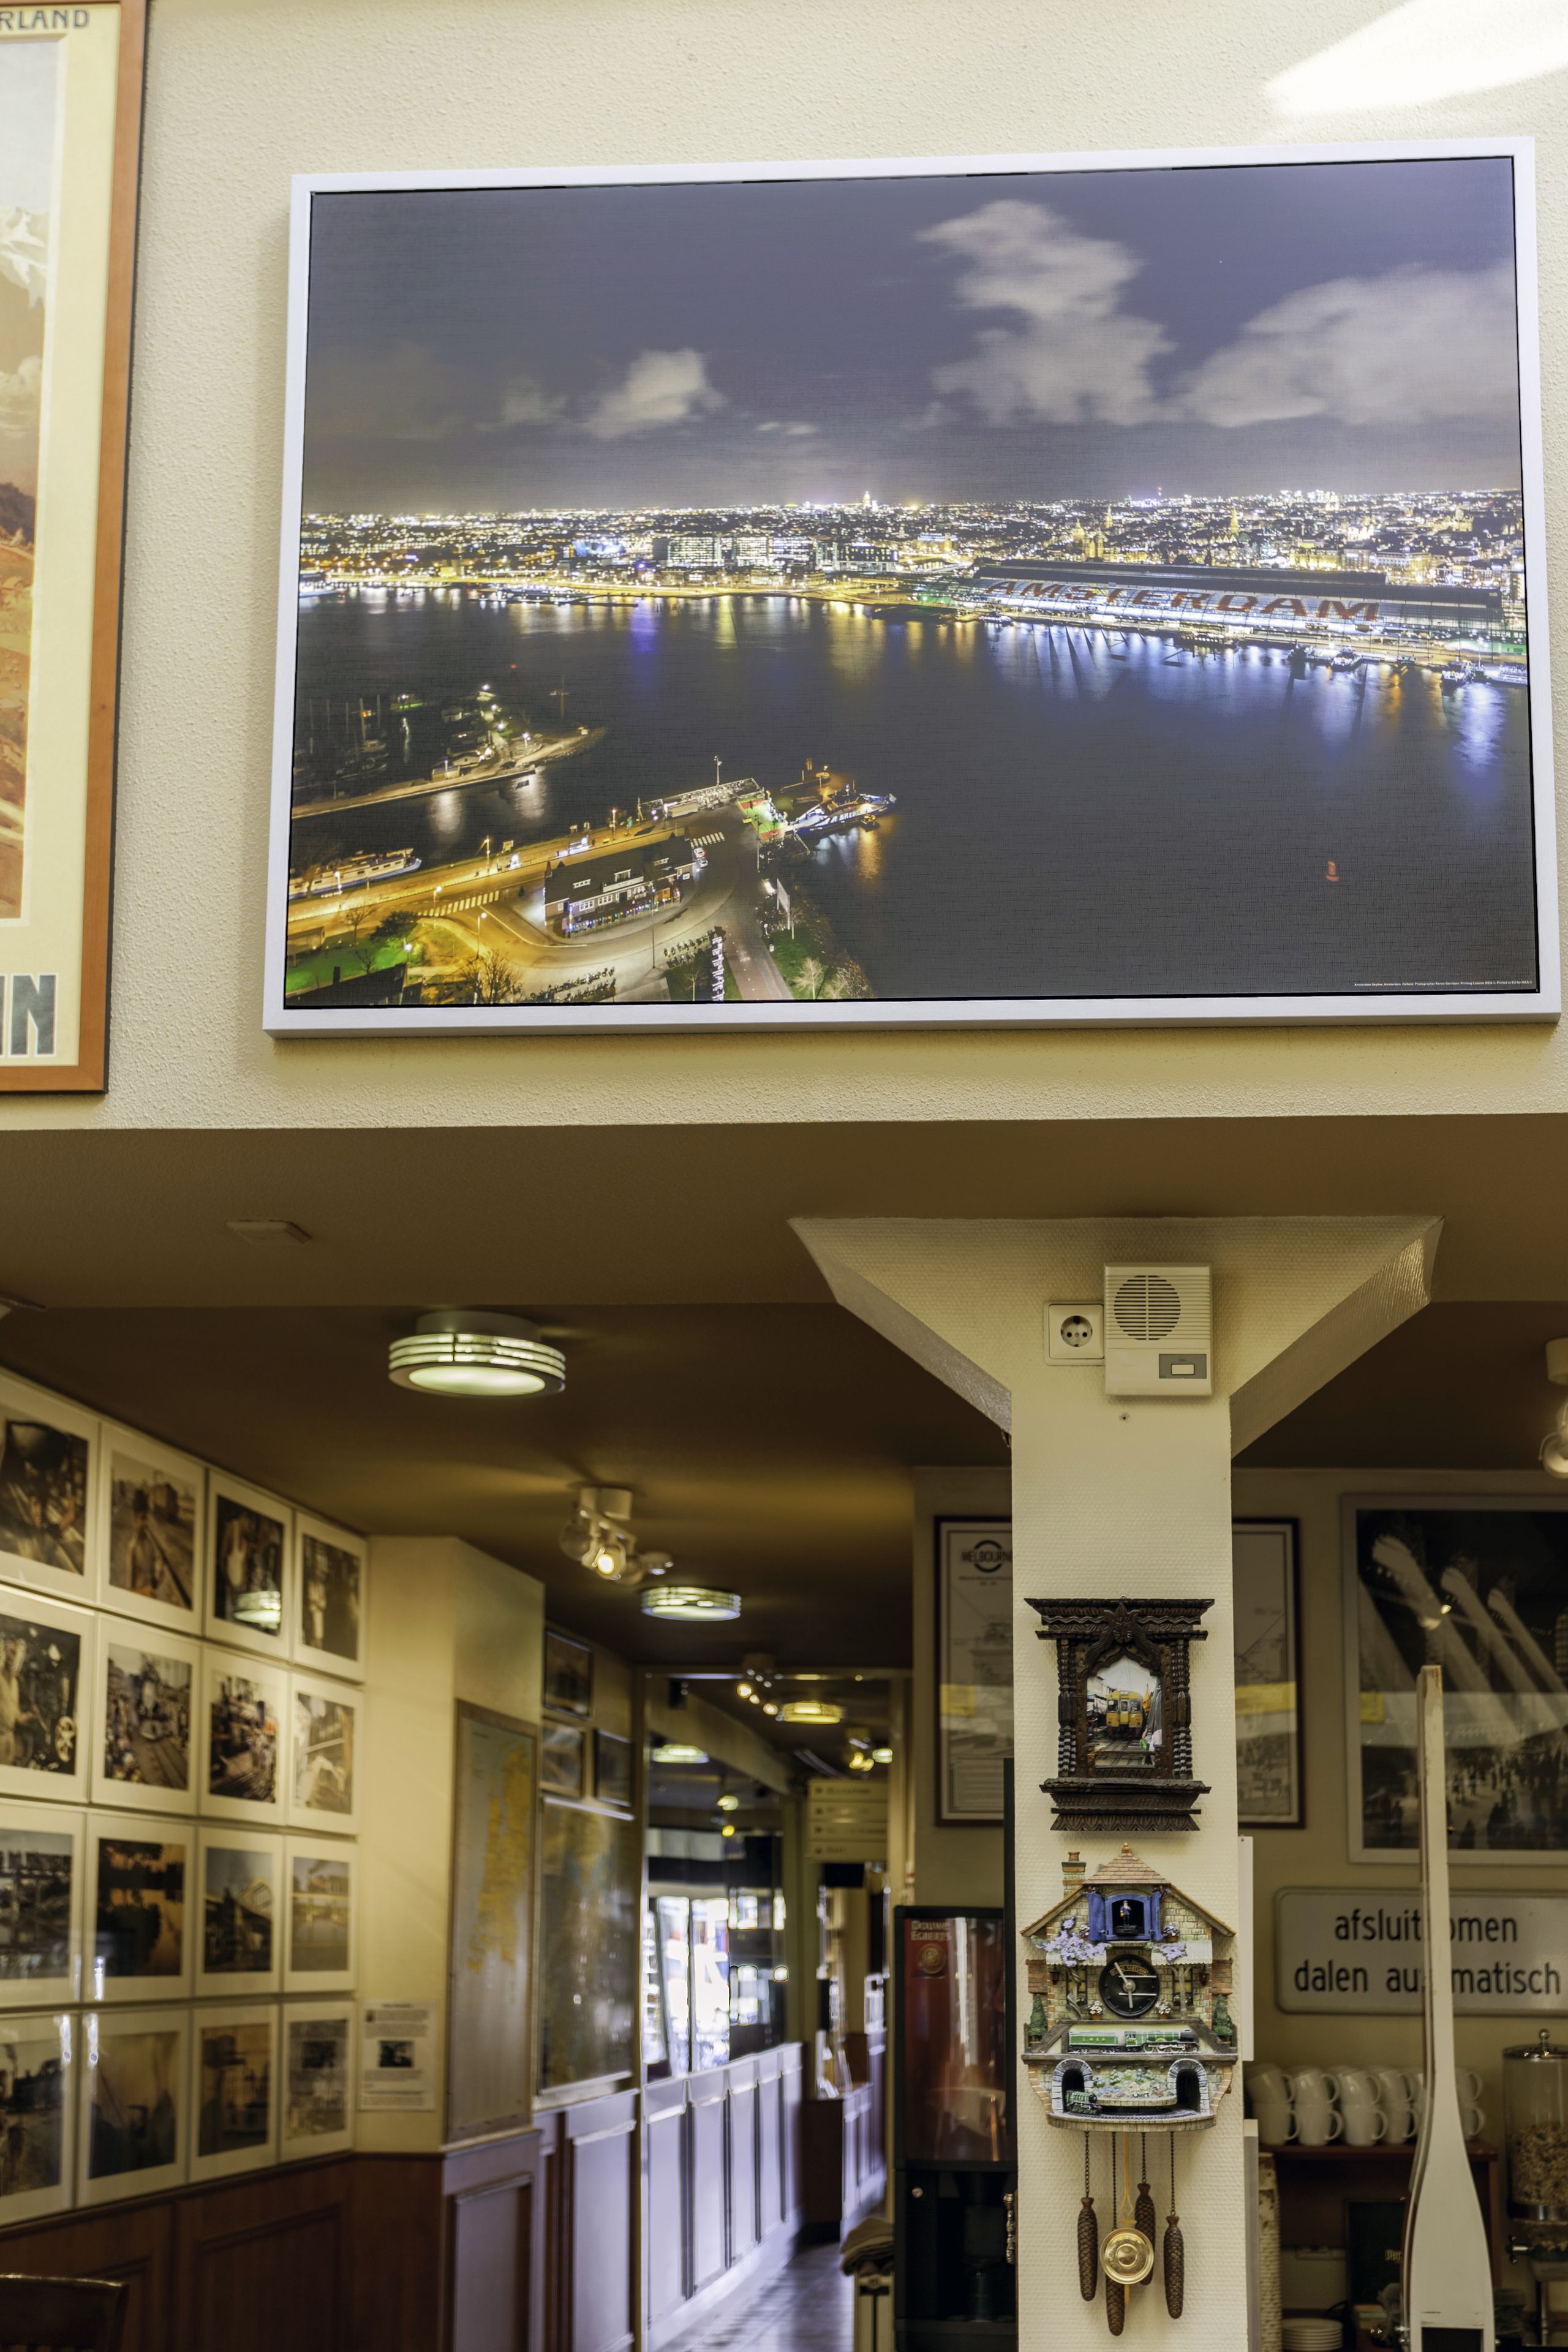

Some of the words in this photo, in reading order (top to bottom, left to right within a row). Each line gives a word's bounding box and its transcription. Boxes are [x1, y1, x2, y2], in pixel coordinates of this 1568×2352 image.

[985, 579, 1379, 622] AMSTERDAM
[1294, 1959, 1368, 1993] dalen
[1385, 1962, 1561, 1996] aumatisch
